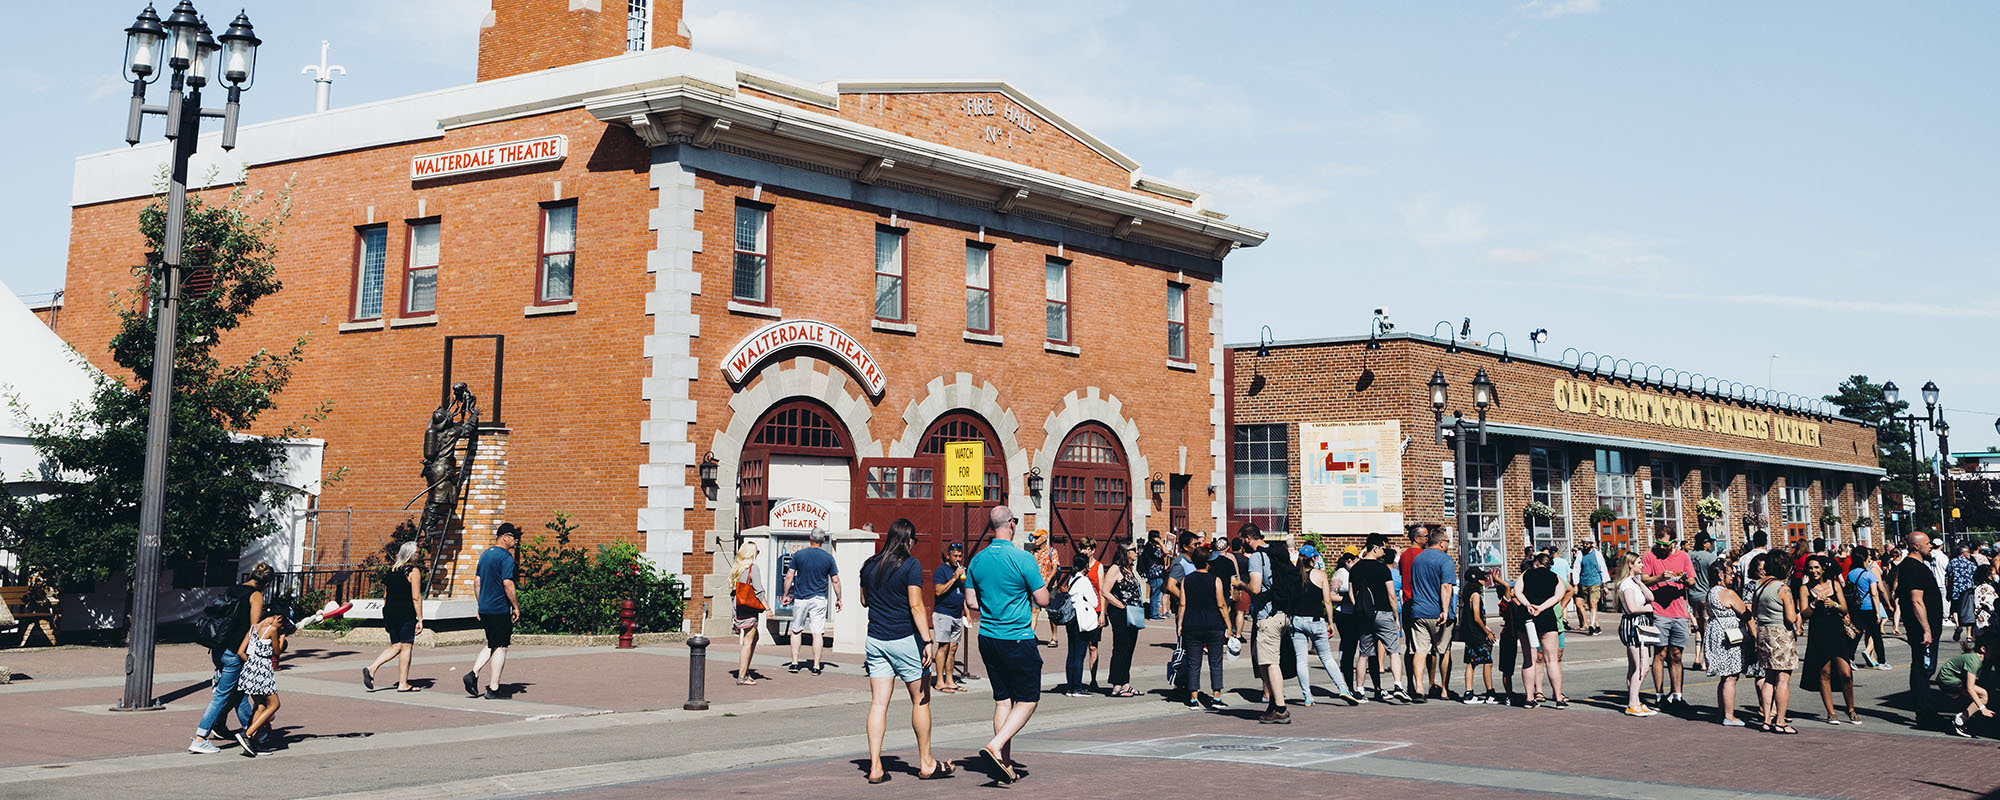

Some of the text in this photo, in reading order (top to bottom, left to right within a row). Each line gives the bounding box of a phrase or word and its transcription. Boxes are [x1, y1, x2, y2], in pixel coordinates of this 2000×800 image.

[967, 98, 1032, 134] FIRE HALL
[415, 140, 557, 176] WALTERDALE THEATRE
[732, 325, 882, 389] WALTERDALE THEATRE
[1553, 378, 1592, 414] OLD
[1595, 385, 1704, 432] STRATHCONA
[1774, 416, 1821, 448] MARKET
[955, 448, 973, 459] WATCH
[959, 466, 970, 477] FOR
[947, 485, 982, 496] PEDESTRIANS
[774, 503, 828, 520] WALTERDALE
[781, 519, 818, 529] THEATRE
